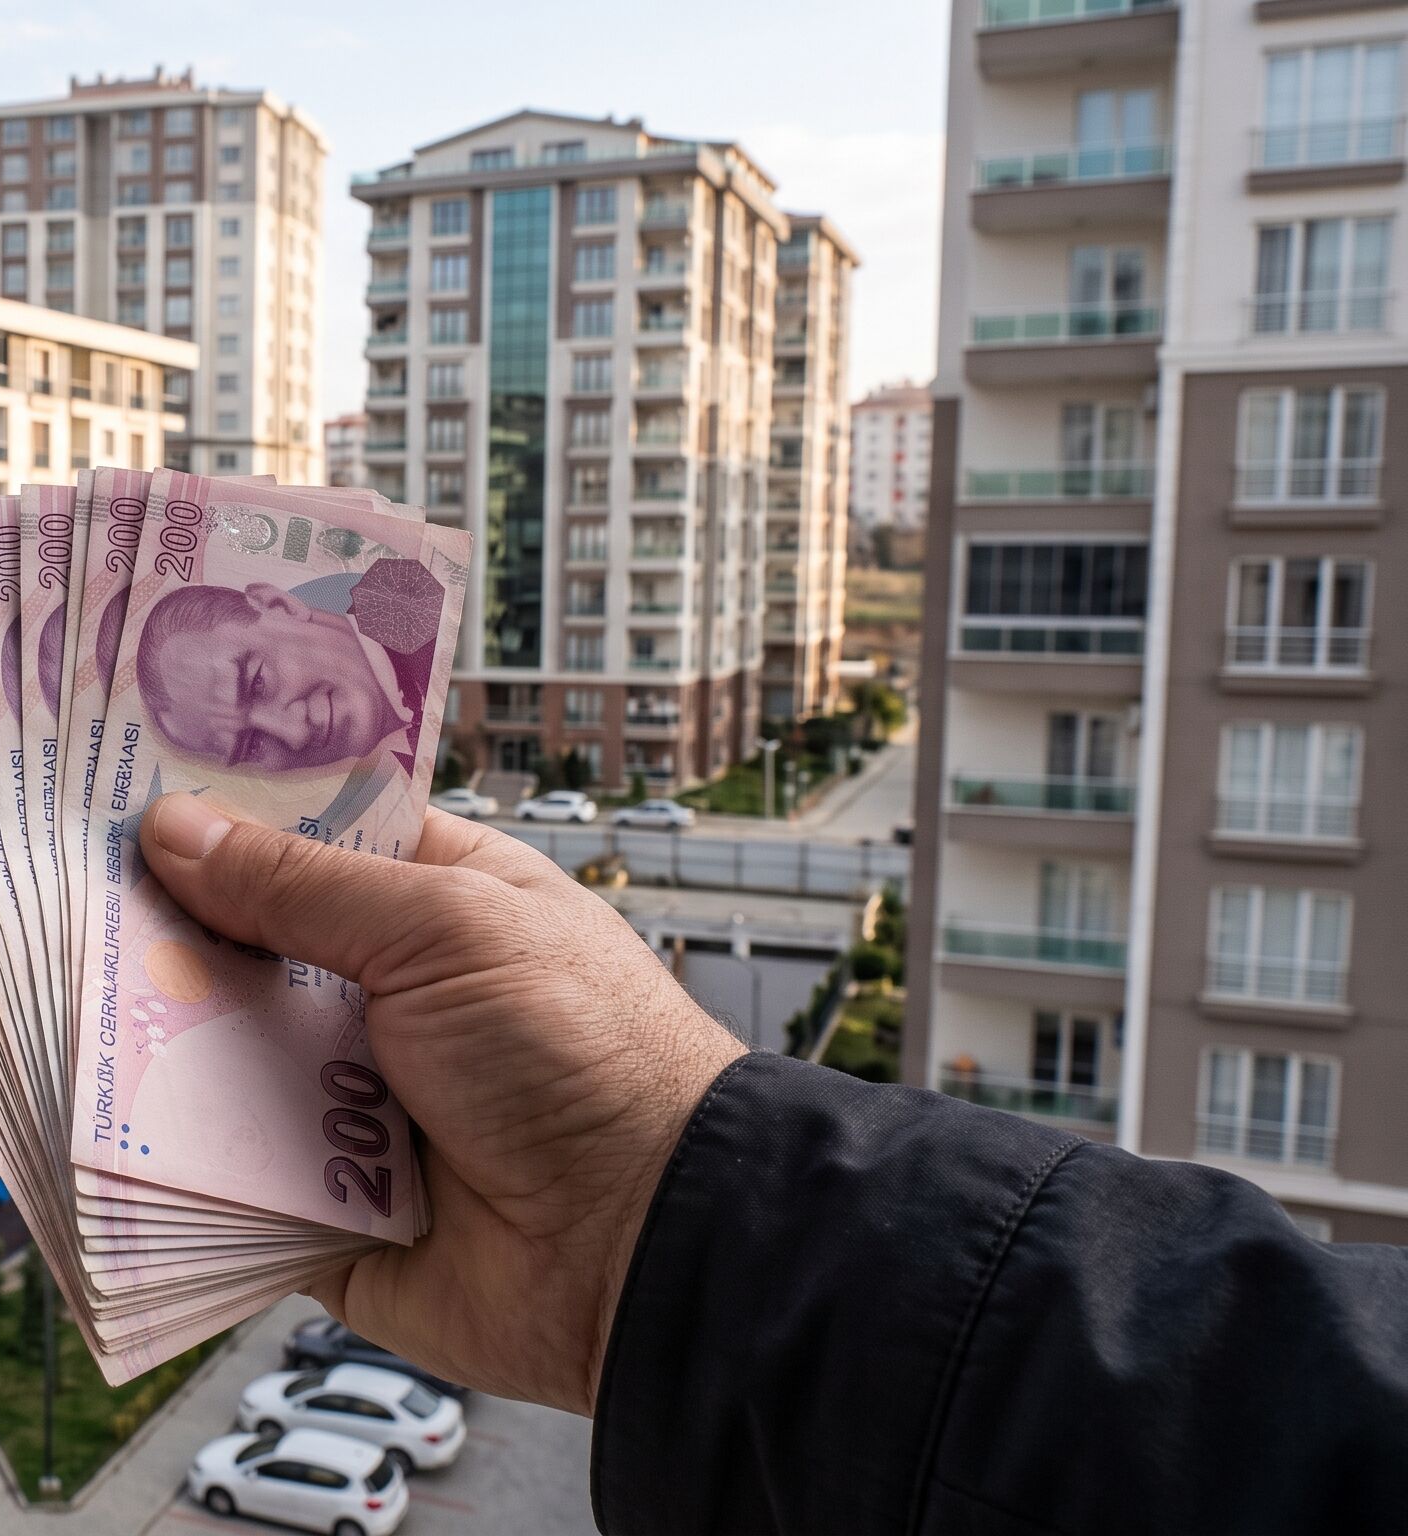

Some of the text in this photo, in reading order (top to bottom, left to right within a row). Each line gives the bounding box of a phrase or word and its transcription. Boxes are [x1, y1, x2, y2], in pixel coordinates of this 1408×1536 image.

[39, 514, 74, 590] 200
[106, 498, 146, 574] 200
[155, 501, 202, 582] 200
[320, 1060, 392, 1218] 200
